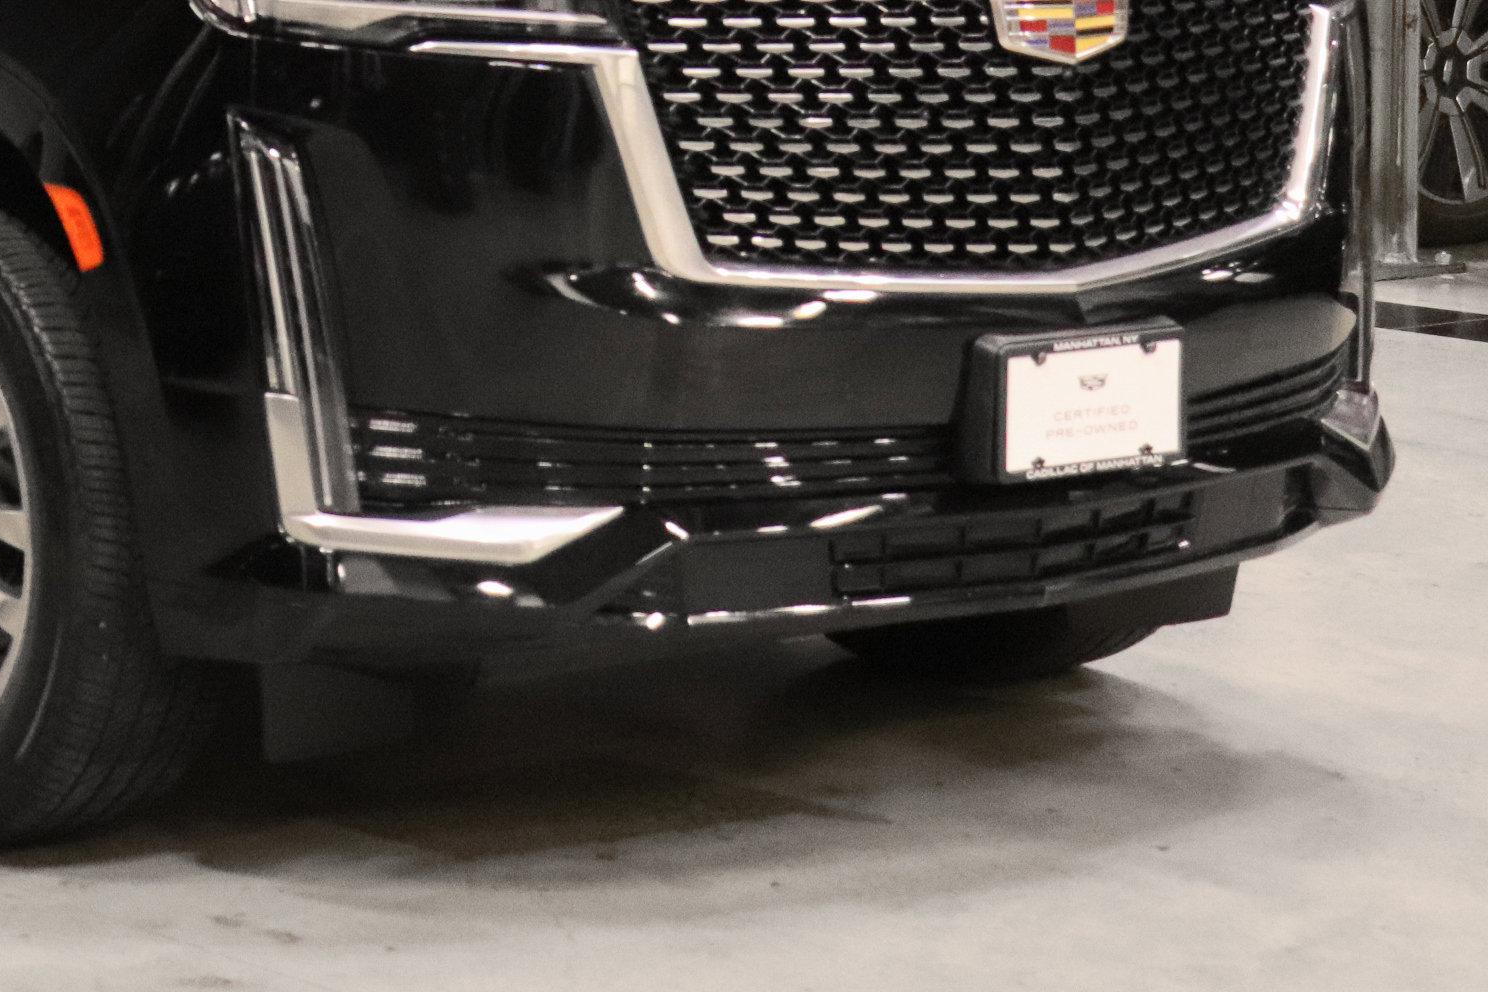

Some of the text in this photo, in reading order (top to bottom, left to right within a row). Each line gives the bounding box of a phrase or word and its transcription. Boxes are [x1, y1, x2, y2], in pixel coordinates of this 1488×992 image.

[1123, 334, 1140, 345] NY
[1053, 404, 1131, 422] CERTIFIED
[1045, 419, 1139, 440] PRE-OWNED
[1025, 454, 1163, 481] CADILLAC OF MANHATTAN
